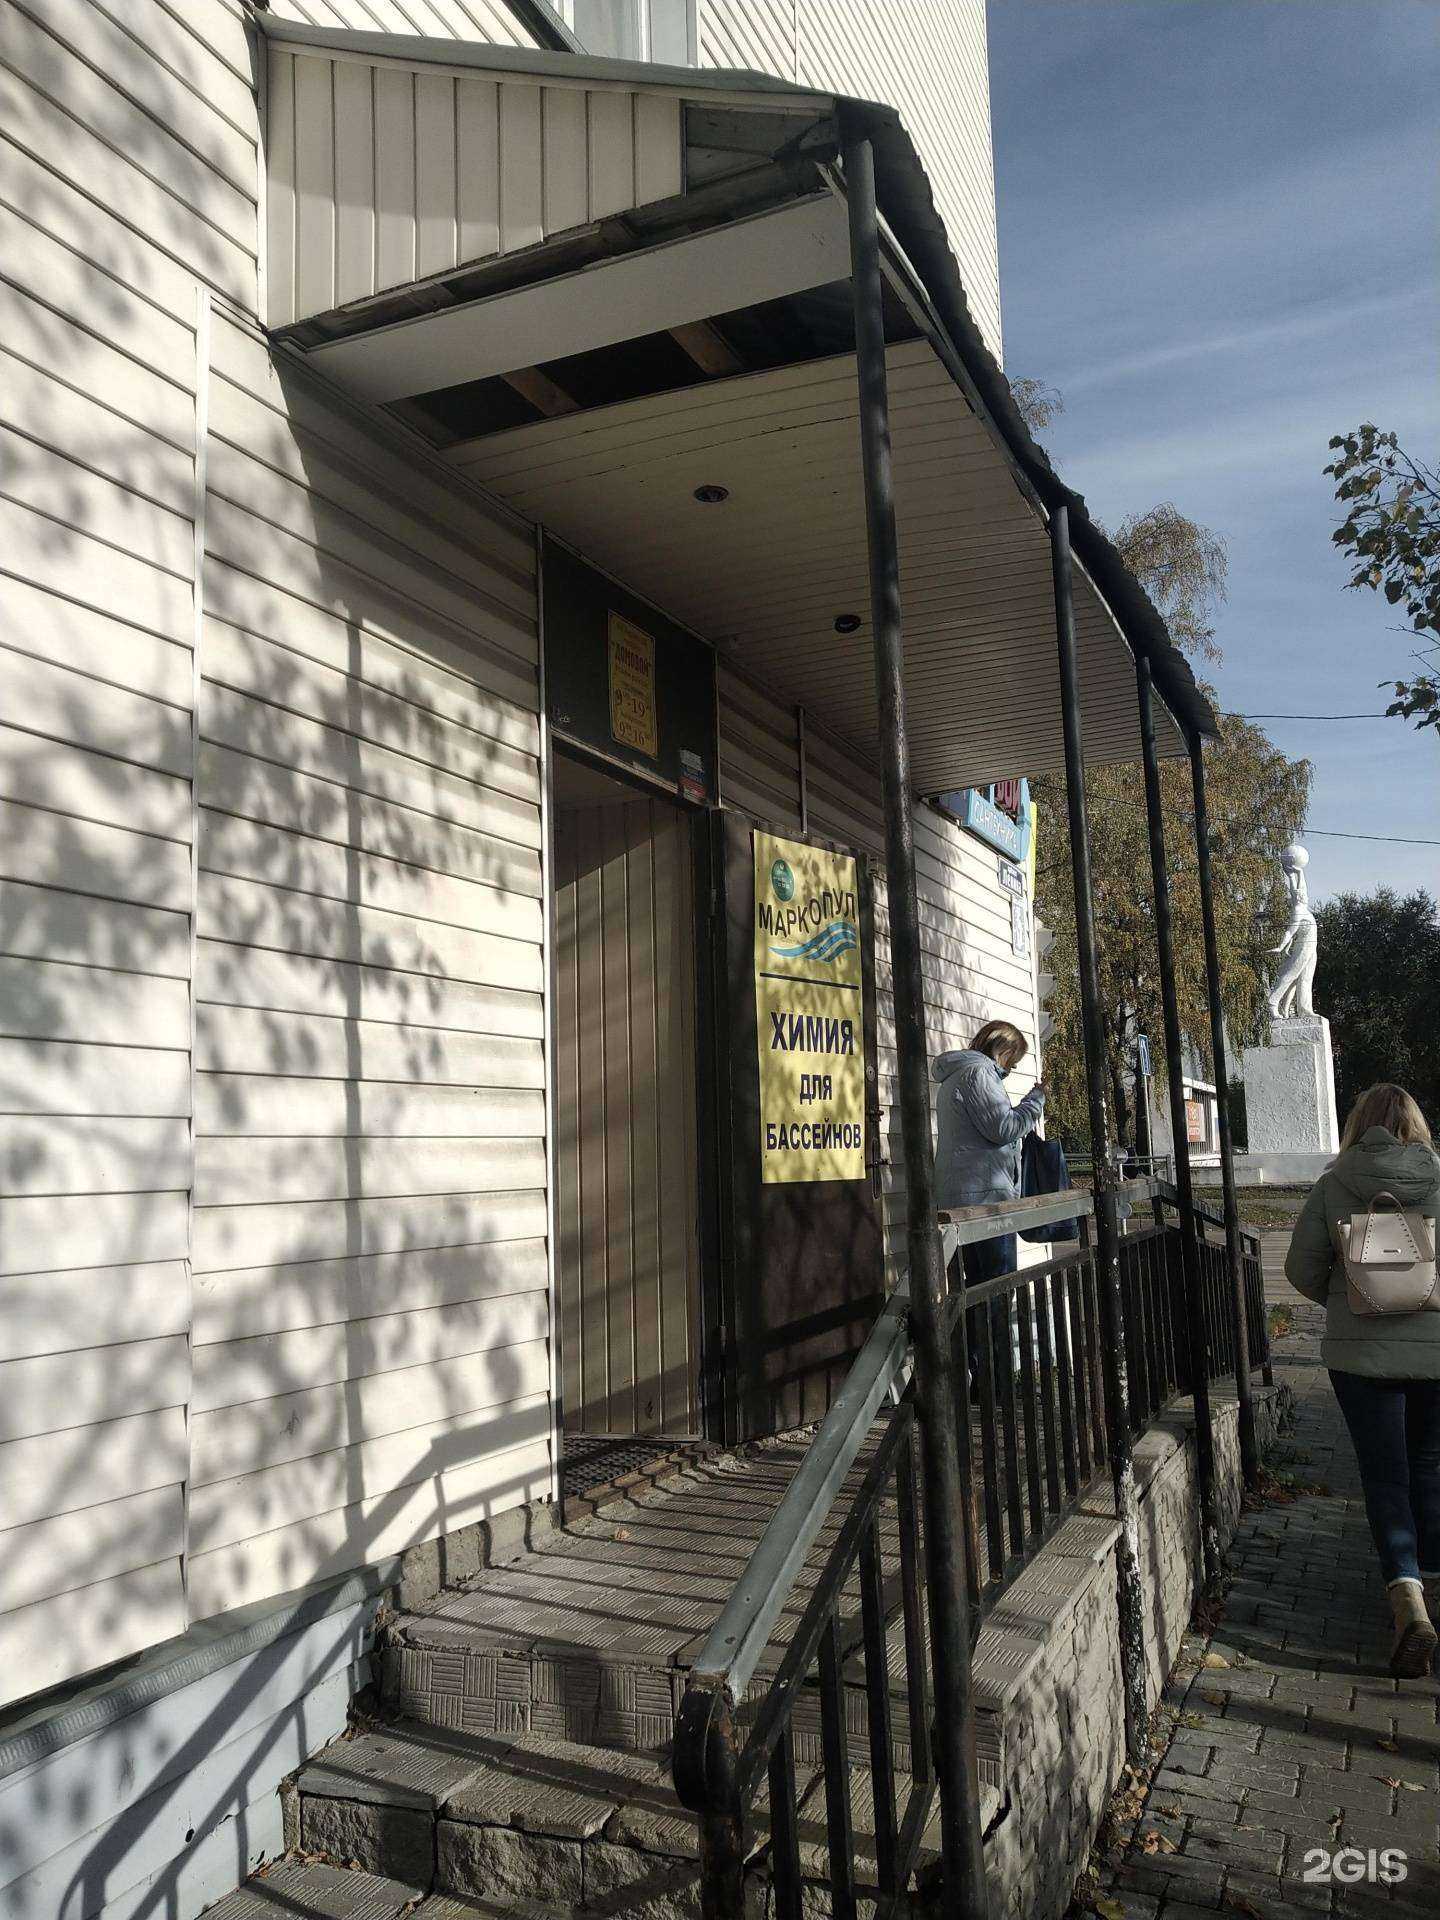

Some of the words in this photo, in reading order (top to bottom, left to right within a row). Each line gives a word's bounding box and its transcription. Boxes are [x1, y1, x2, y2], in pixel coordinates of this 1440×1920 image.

[758, 888, 856, 938] МАРКОПУЛ
[770, 1011, 854, 1055] ХИМИЯ
[799, 1073, 833, 1106] ДЛЯ
[766, 1117, 862, 1151] БАССЕЙНОВ
